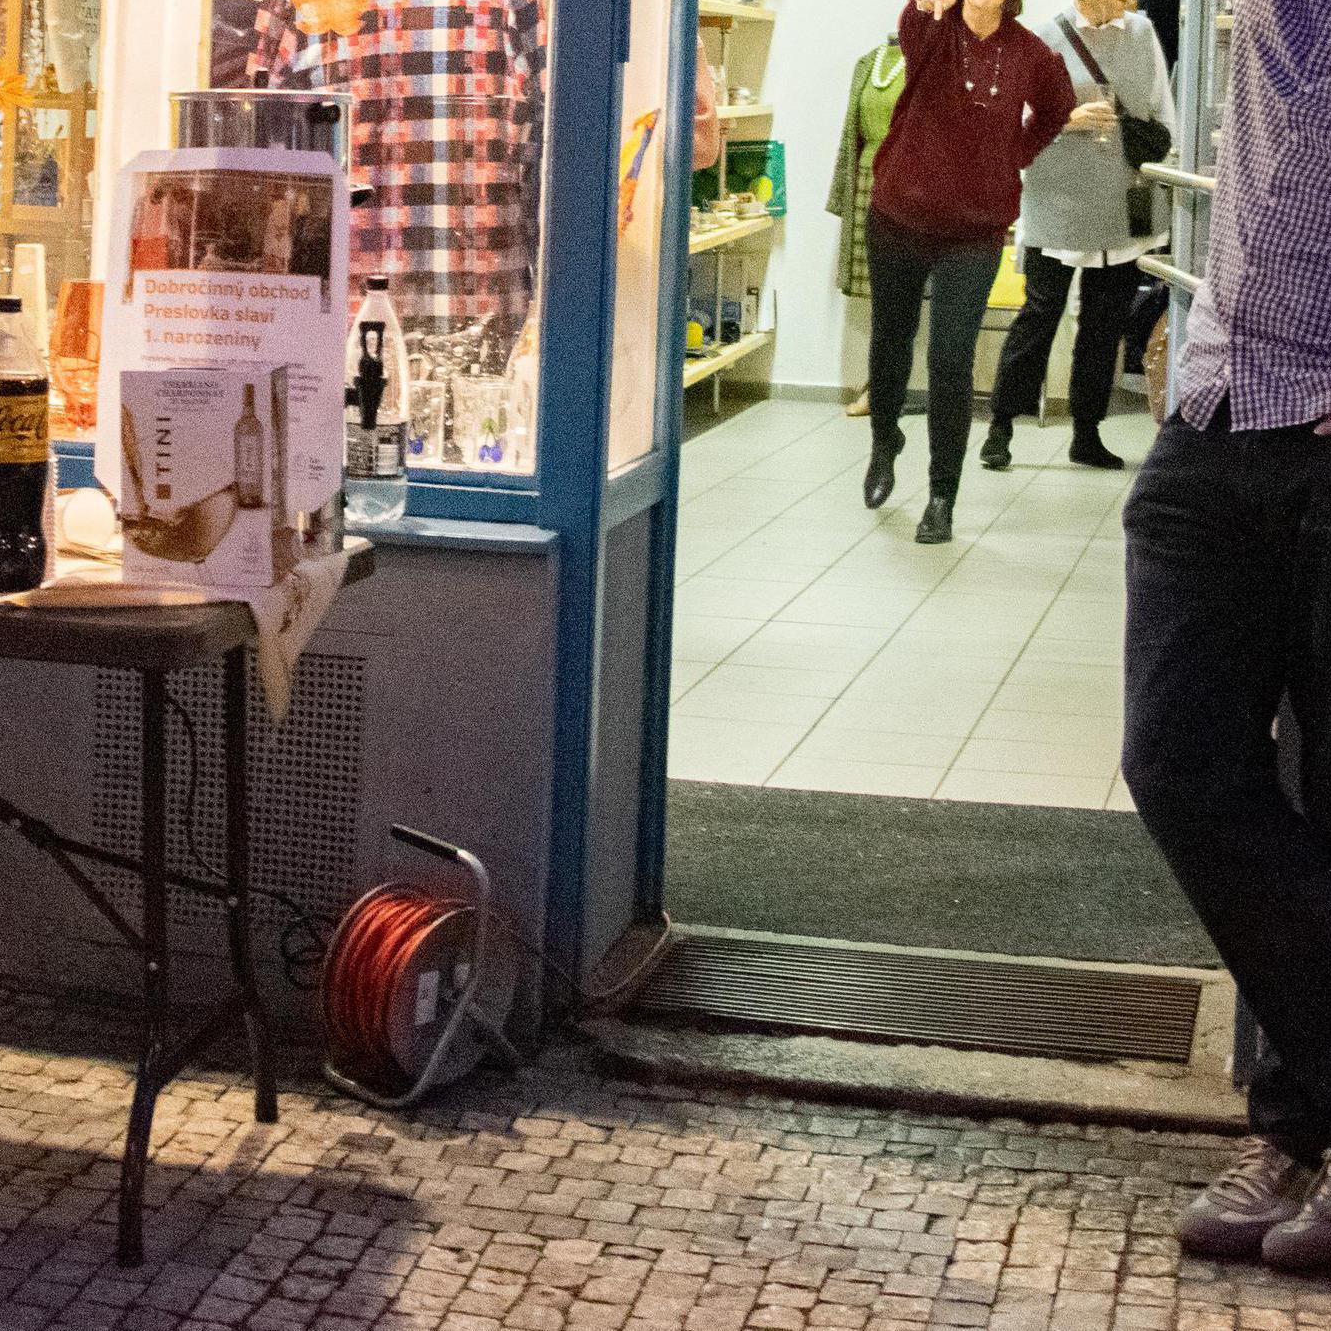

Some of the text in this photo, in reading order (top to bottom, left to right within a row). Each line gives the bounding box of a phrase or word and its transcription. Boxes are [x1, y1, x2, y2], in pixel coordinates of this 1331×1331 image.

[144, 278, 311, 301] Dobročinný obchod
[143, 303, 231, 322] Preslovka
[162, 329, 262, 352] narozeniny
